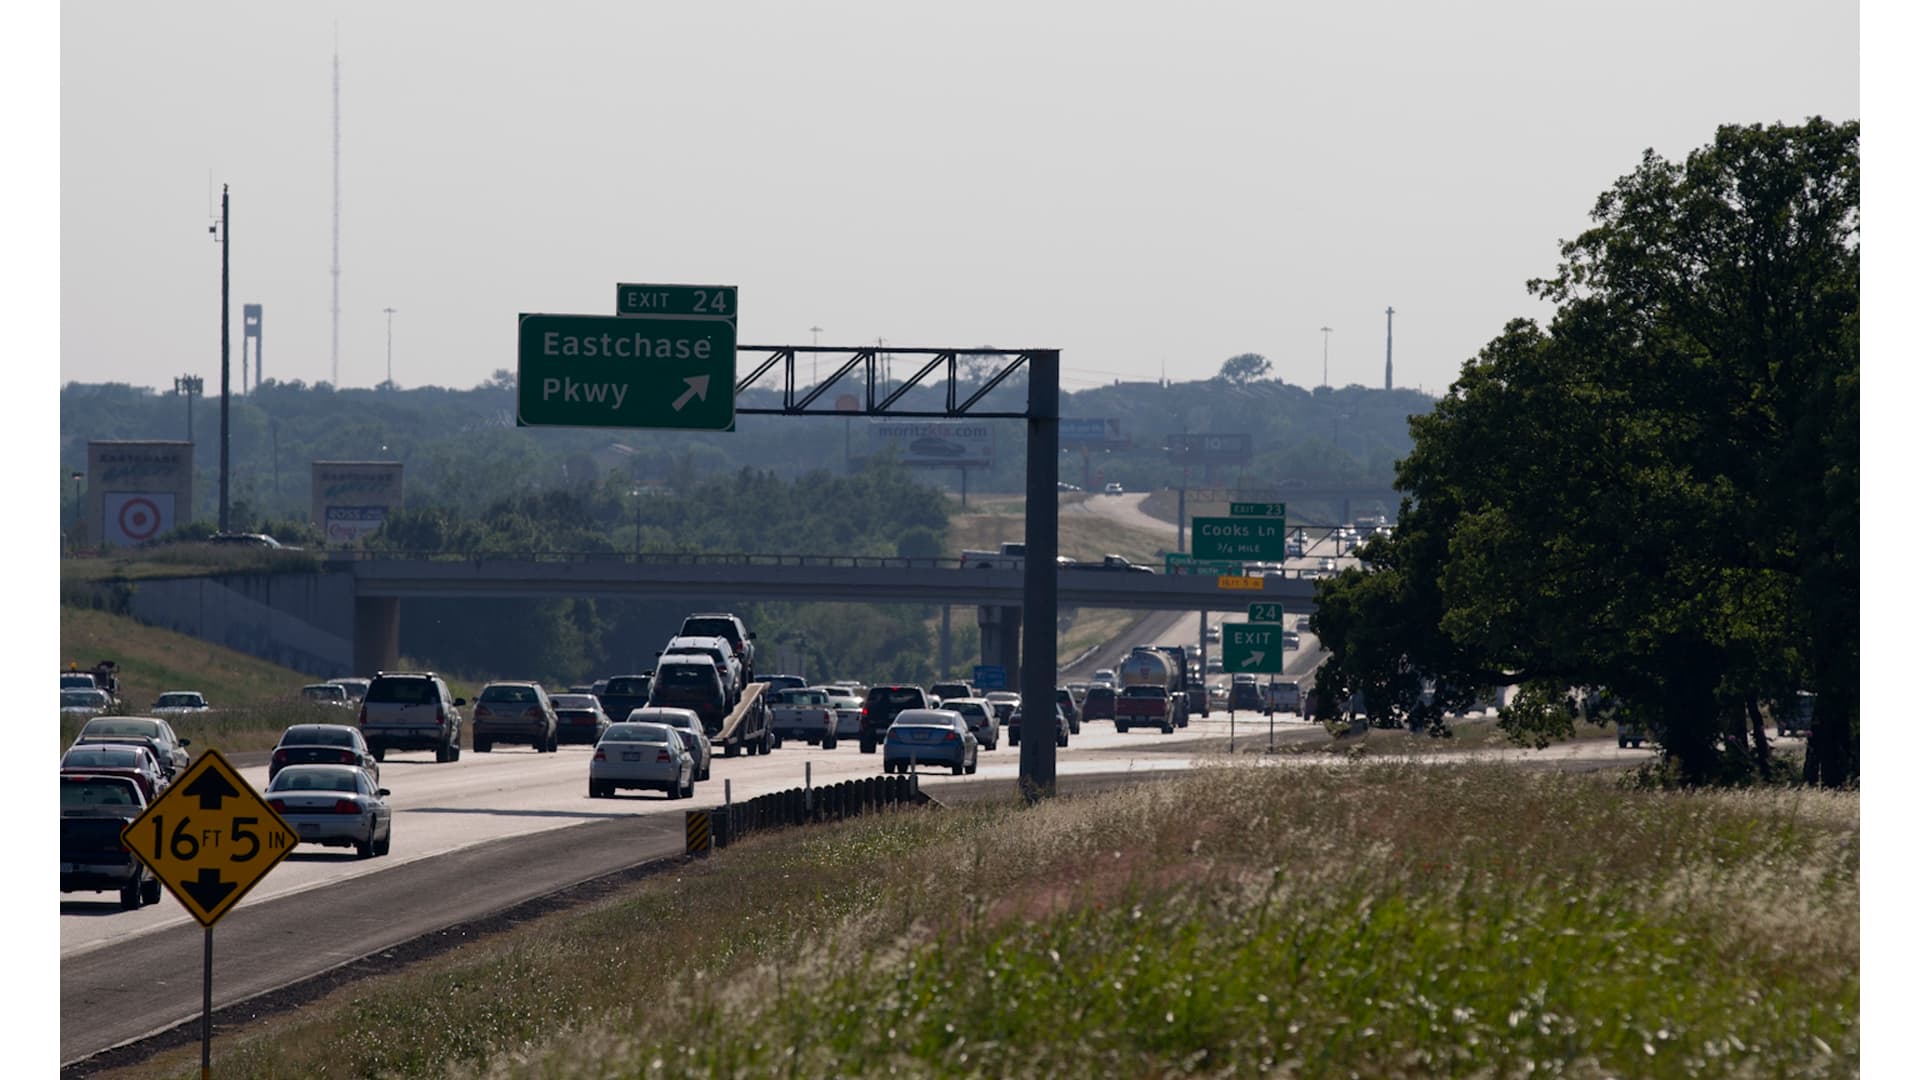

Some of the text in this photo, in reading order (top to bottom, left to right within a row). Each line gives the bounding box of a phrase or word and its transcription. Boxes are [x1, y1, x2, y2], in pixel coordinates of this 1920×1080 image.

[627, 290, 727, 312] EXIT 24
[543, 332, 712, 359] Eastchase
[543, 377, 629, 409] Pkwy
[1233, 504, 1282, 515] EXIT 23
[1202, 523, 1276, 537] Cooks Ln
[1238, 544, 1261, 553] MILE
[1255, 605, 1277, 620] 24
[1233, 631, 1272, 645] EXIT
[152, 815, 285, 862] 16 FT 5 IN
